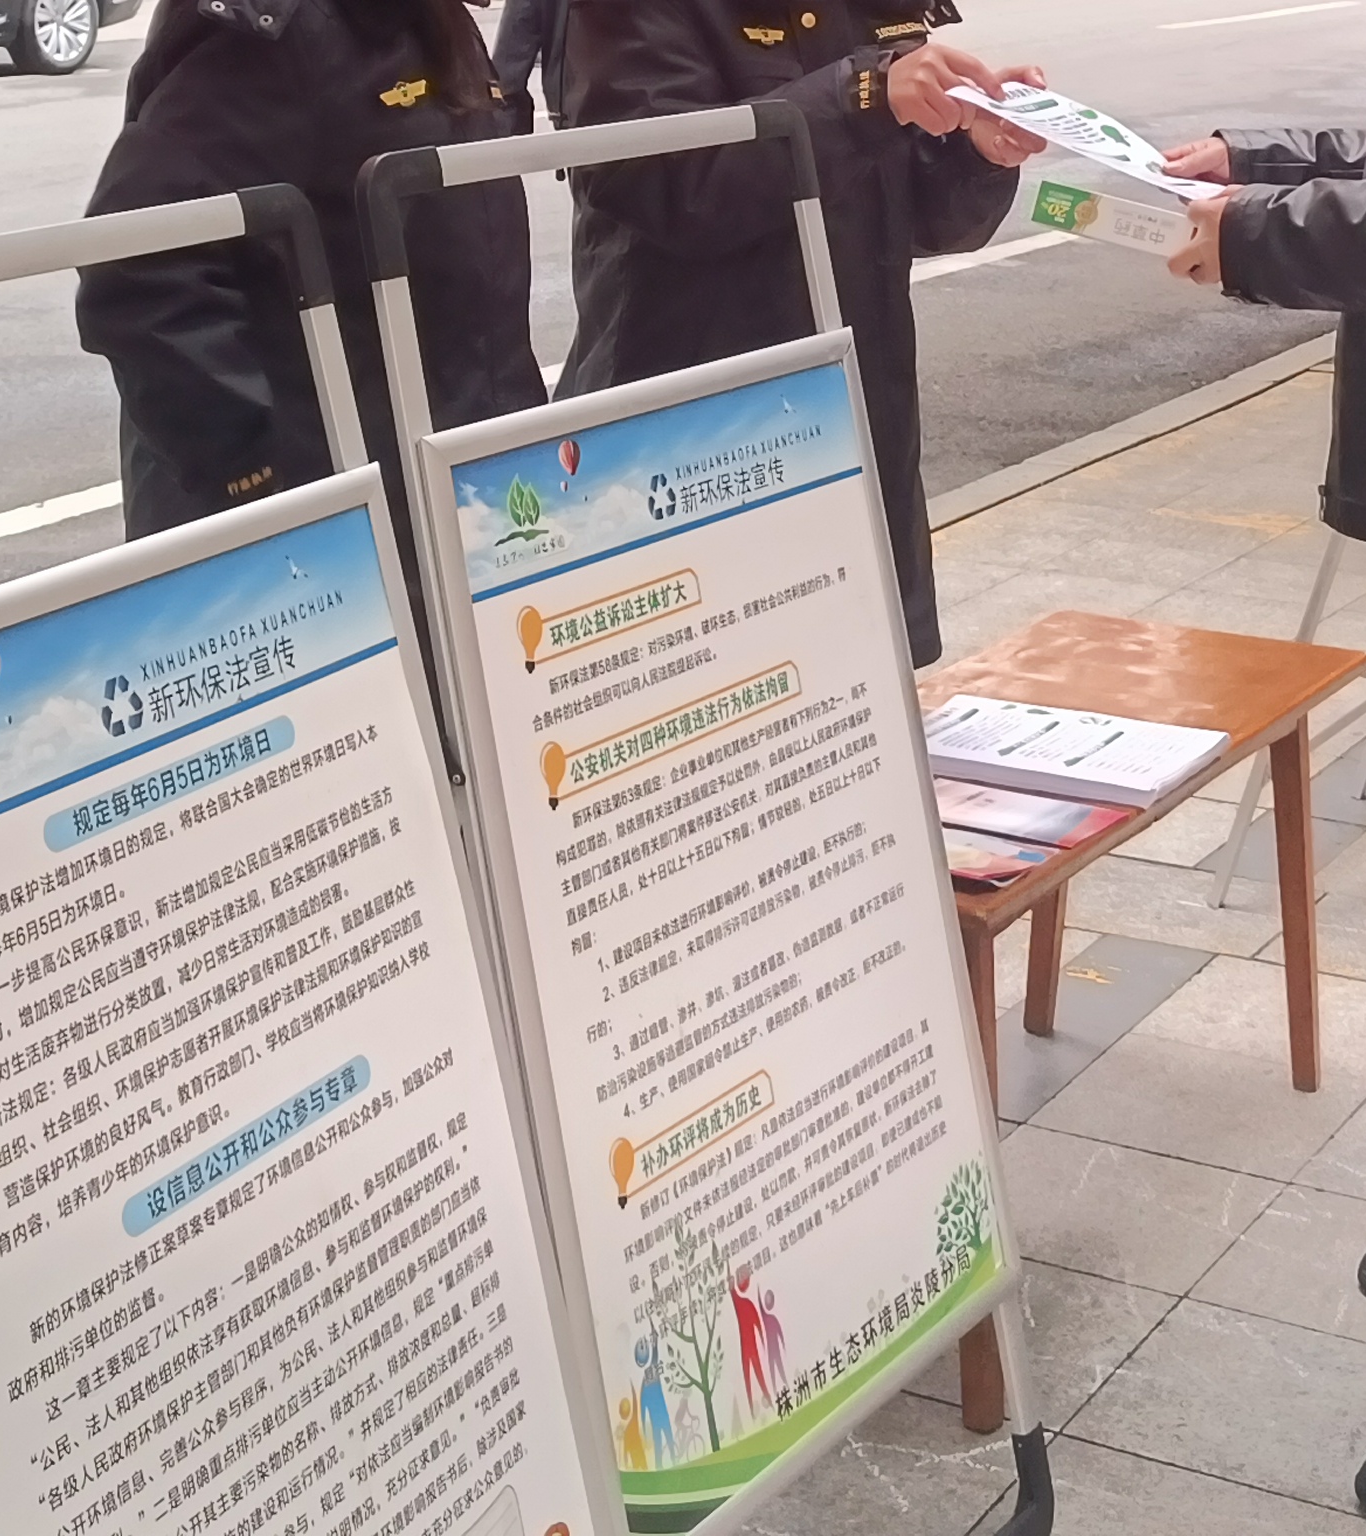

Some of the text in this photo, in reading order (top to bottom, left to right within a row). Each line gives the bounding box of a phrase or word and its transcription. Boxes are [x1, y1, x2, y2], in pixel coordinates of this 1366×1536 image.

[679, 455, 784, 514] 新环保法宣传
[139, 590, 342, 681] XINHUANBAOFA XUANCHUAN
[549, 579, 687, 647] 环境公益诉讼主体扩大
[147, 634, 295, 723] 新环保法宣传
[570, 670, 788, 783] 公安机关对四种环境违法行为依法拘留
[72, 727, 271, 837] 规定每年6月5日为环境日
[146, 1064, 358, 1223] 设信息公开和公众参与专章
[640, 1084, 765, 1178] 补办环评将成为历史
[6, 1286, 163, 1403] 政府和排污单位的监督。
[773, 1241, 971, 1421] 株洲市生态环境局炎陵分局
